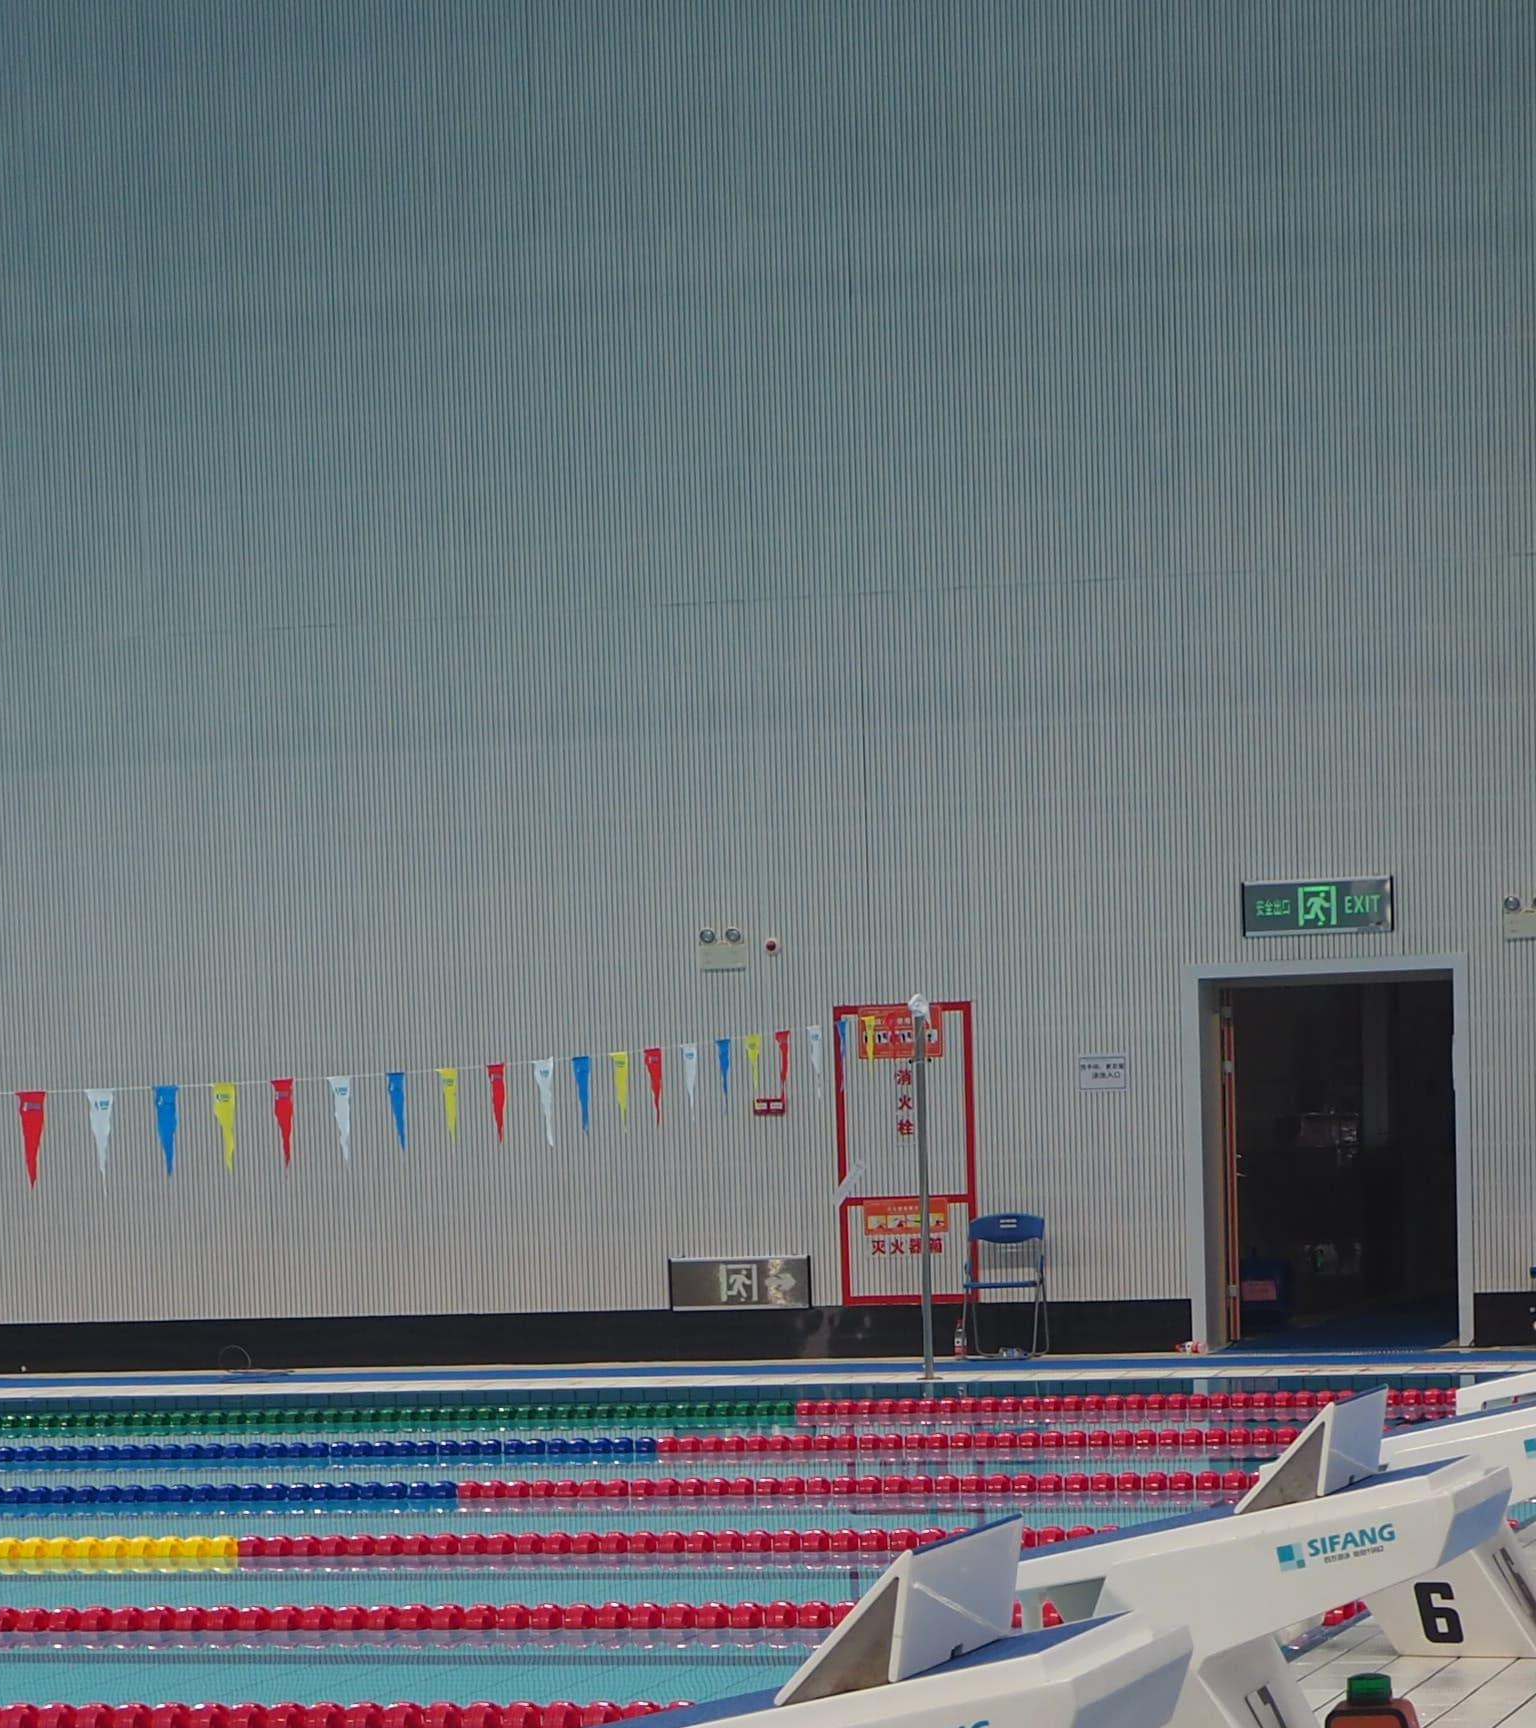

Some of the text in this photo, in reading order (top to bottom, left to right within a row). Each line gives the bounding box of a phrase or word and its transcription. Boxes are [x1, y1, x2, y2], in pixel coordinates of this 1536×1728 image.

[1344, 895, 1380, 913] EXIT
[896, 1069, 913, 1135] 消火栓
[1307, 1523, 1396, 1557] SIFANG
[1414, 1582, 1464, 1643] 6
